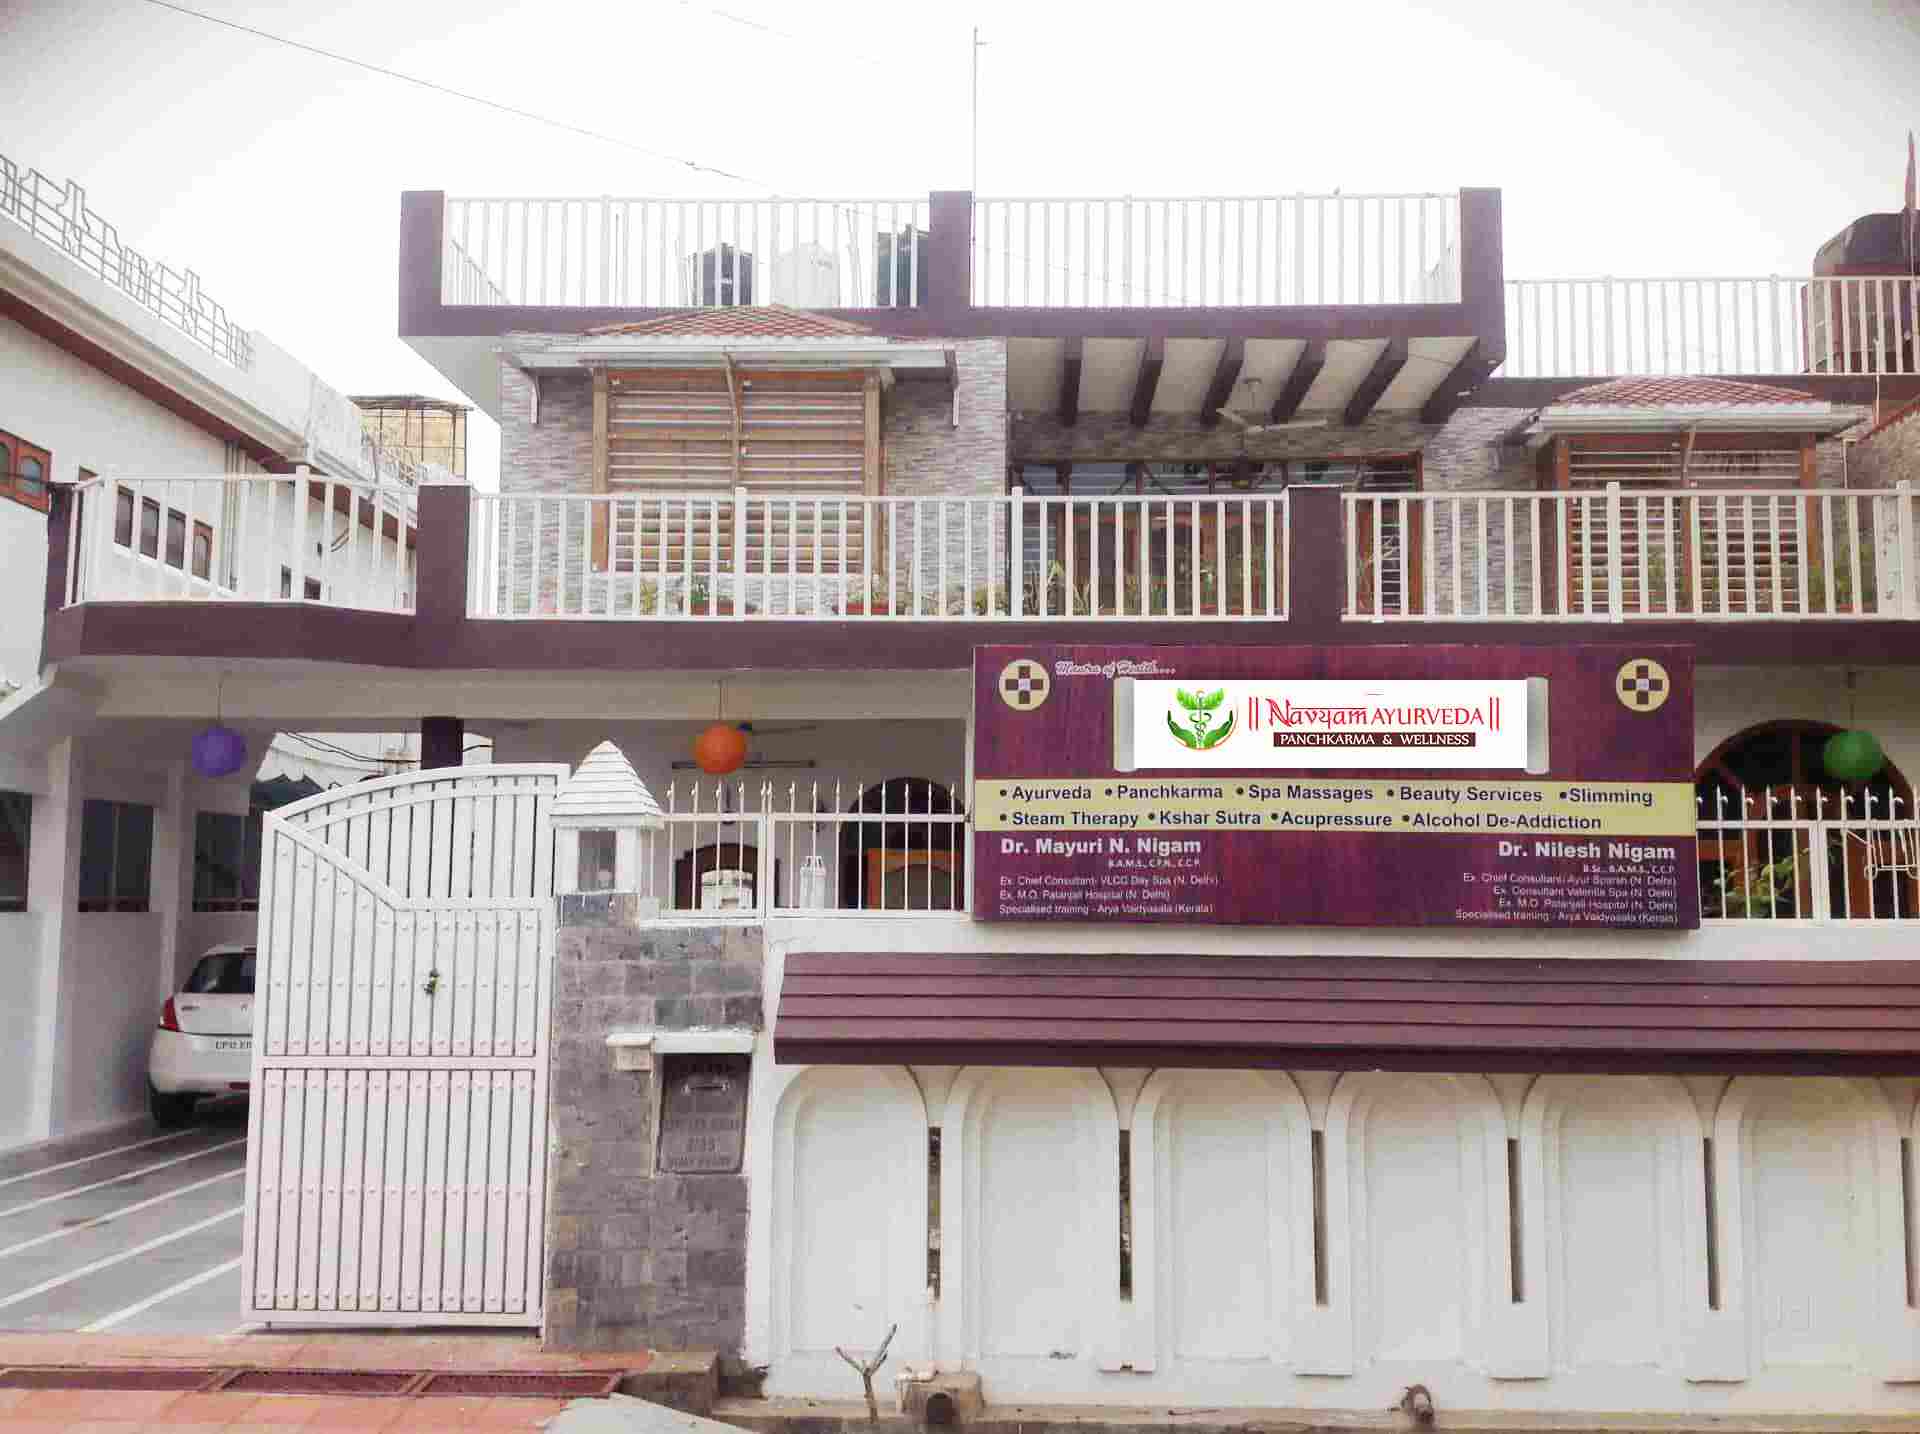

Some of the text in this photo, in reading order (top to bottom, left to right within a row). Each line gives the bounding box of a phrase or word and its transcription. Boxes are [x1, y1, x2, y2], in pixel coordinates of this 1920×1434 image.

[1102, 661, 1116, 679] of
[1265, 698, 1484, 730] Navyam AYURVEDA
[1280, 734, 1470, 745] PANCHKARMA & WELLNESS
[1012, 784, 1653, 806] Ayurveda Panchkarma Spa Massages Beauty Services Slimming
[1012, 810, 1602, 829] Steam Therapy Kshar Sutra Acupressure Alcohol De-Addiction
[1001, 838, 1201, 857] Dr. Mayuri N. Nigam
[1499, 841, 1676, 862] Dr. Nilesh Nigam
